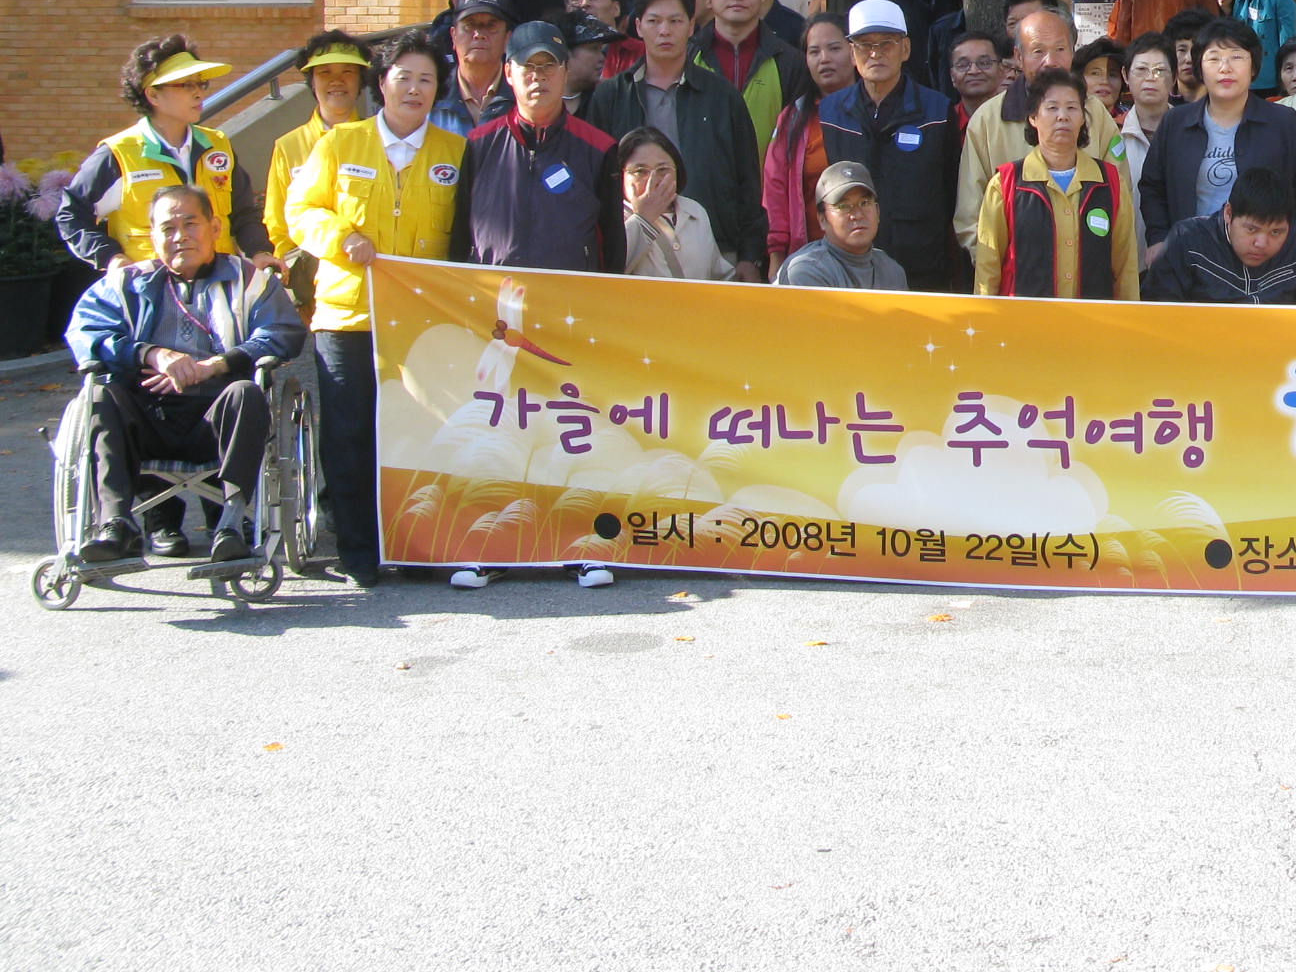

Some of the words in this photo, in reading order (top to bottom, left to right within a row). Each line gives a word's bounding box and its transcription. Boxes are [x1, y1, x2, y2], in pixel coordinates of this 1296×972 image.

[473, 382, 670, 455] 가을에
[708, 391, 905, 465] 떠나는
[946, 390, 1214, 470] 추억여행
[739, 517, 857, 558] 2008년
[875, 526, 948, 564] 10월
[964, 531, 1100, 569] 22일(수)
